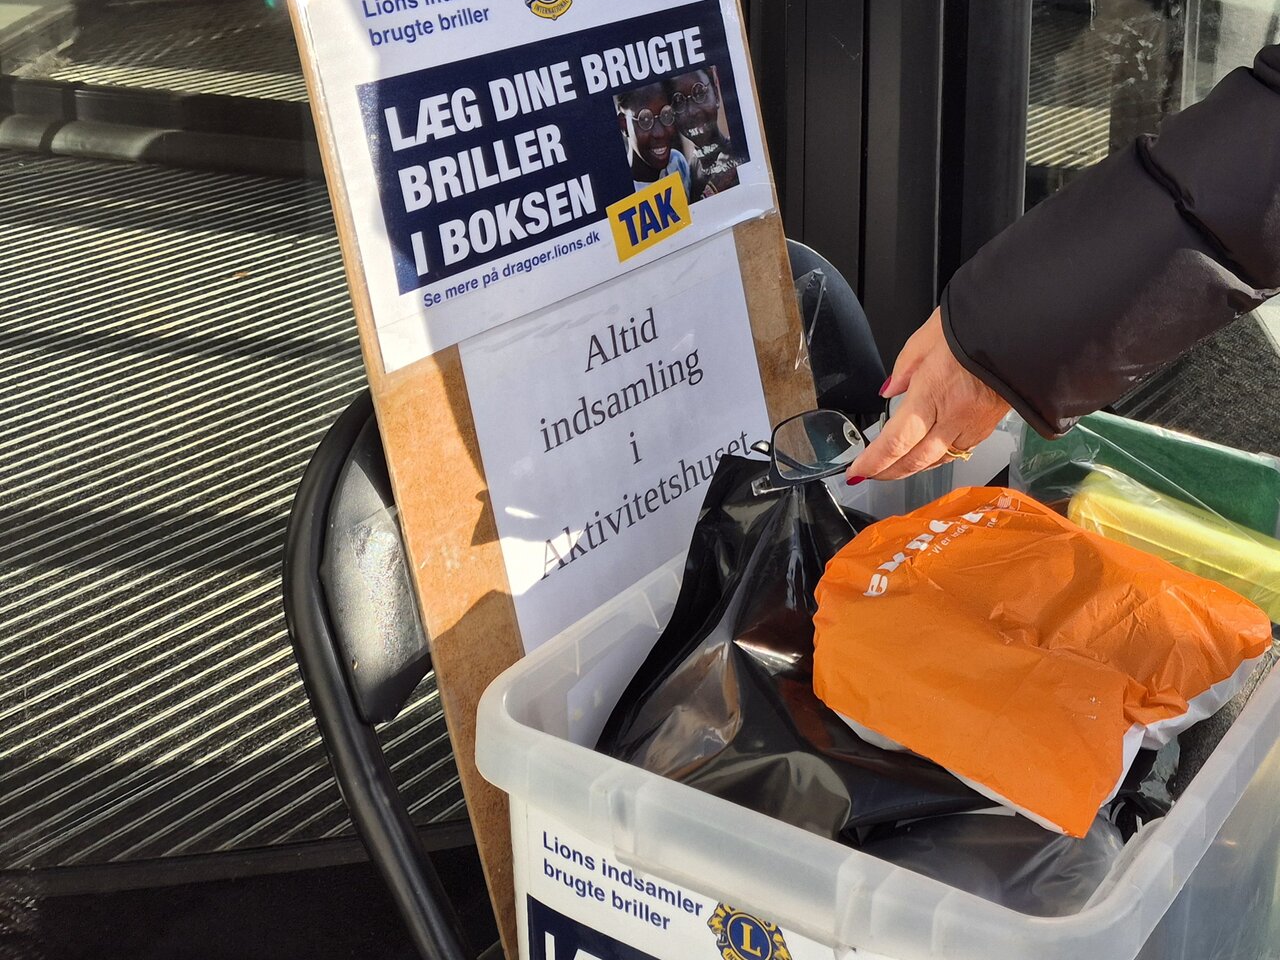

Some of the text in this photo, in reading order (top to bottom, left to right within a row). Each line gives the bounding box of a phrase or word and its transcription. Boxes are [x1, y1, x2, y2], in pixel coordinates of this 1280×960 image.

[368, 6, 490, 48] brugte briller
[383, 25, 706, 153] LÆG DINE BRUGTE
[397, 123, 568, 214] BRILLER
[411, 174, 597, 277] I BOKSEN
[618, 187, 681, 246] TAK
[424, 230, 601, 308] Se mere på dragoer.lions.dk
[584, 307, 659, 372] Altid
[538, 348, 705, 453] indsamling
[629, 431, 643, 465] i
[543, 831, 595, 871] Lions
[601, 858, 703, 916] indsamler
[543, 858, 670, 930] brugte briller
[740, 921, 762, 957] L
